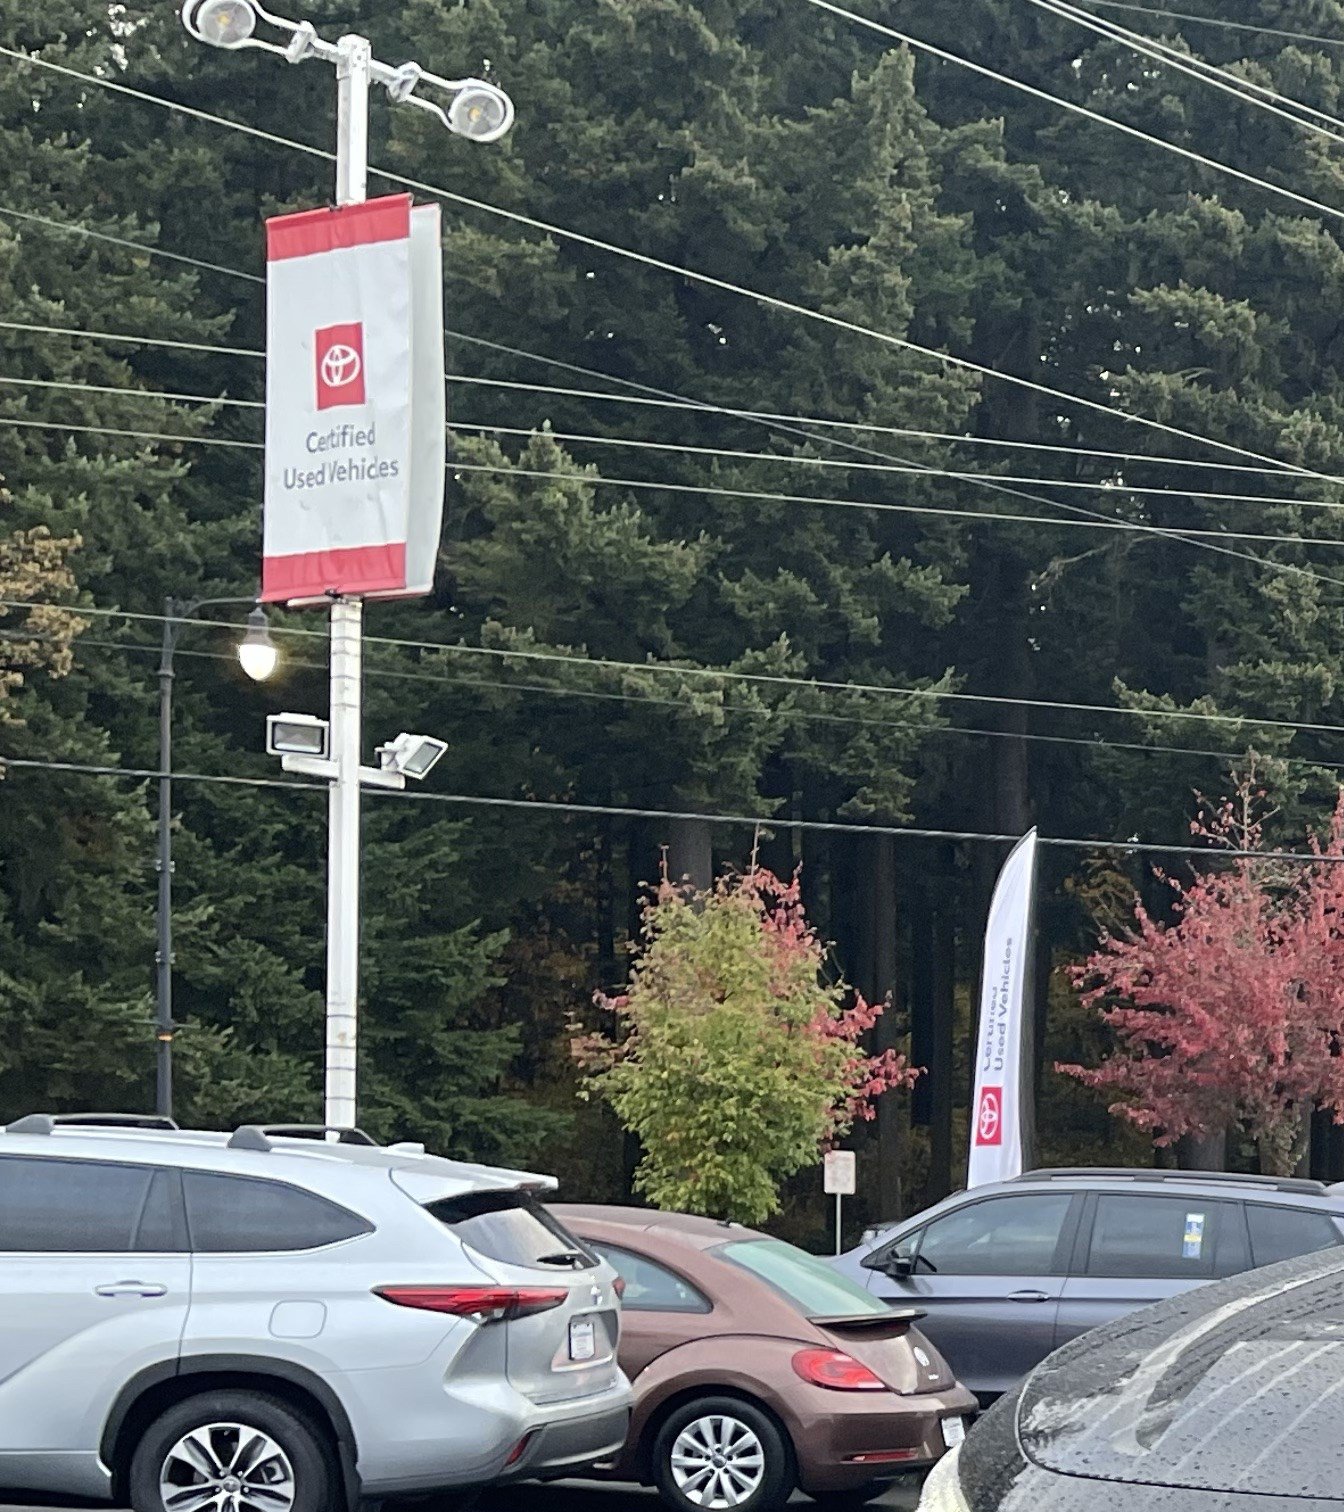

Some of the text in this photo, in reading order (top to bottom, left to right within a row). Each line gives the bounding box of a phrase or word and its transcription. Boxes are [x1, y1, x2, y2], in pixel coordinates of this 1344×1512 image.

[306, 421, 376, 453] Certified
[284, 456, 399, 489] Used Vehicles
[994, 938, 1013, 1071] Used Vehicles
